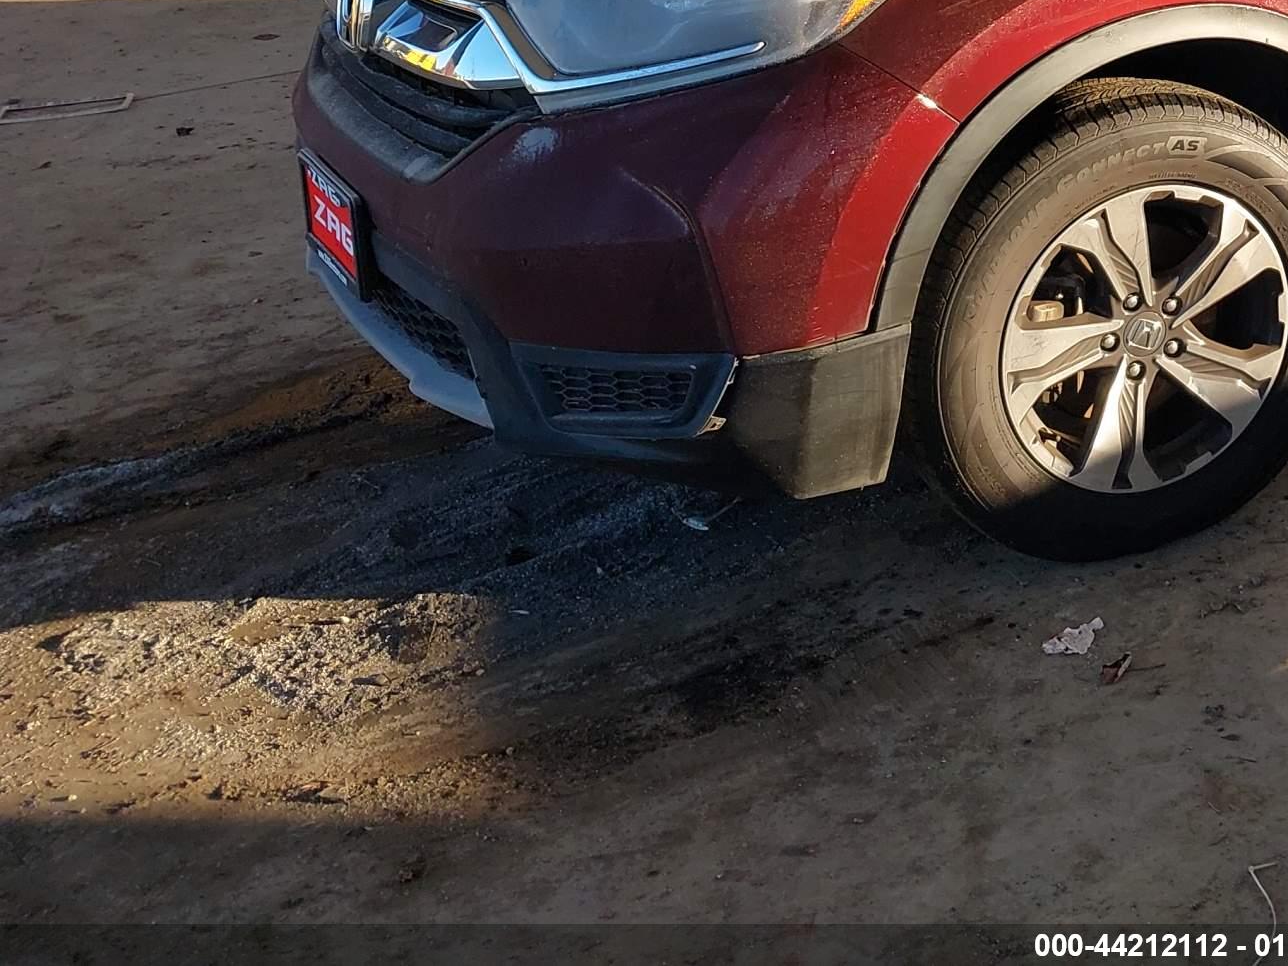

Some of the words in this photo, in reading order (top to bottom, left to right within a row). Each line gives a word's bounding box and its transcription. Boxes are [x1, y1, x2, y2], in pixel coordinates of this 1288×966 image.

[1170, 138, 1201, 152] AS
[309, 167, 341, 208] ZAG
[314, 195, 354, 256] ZAG
